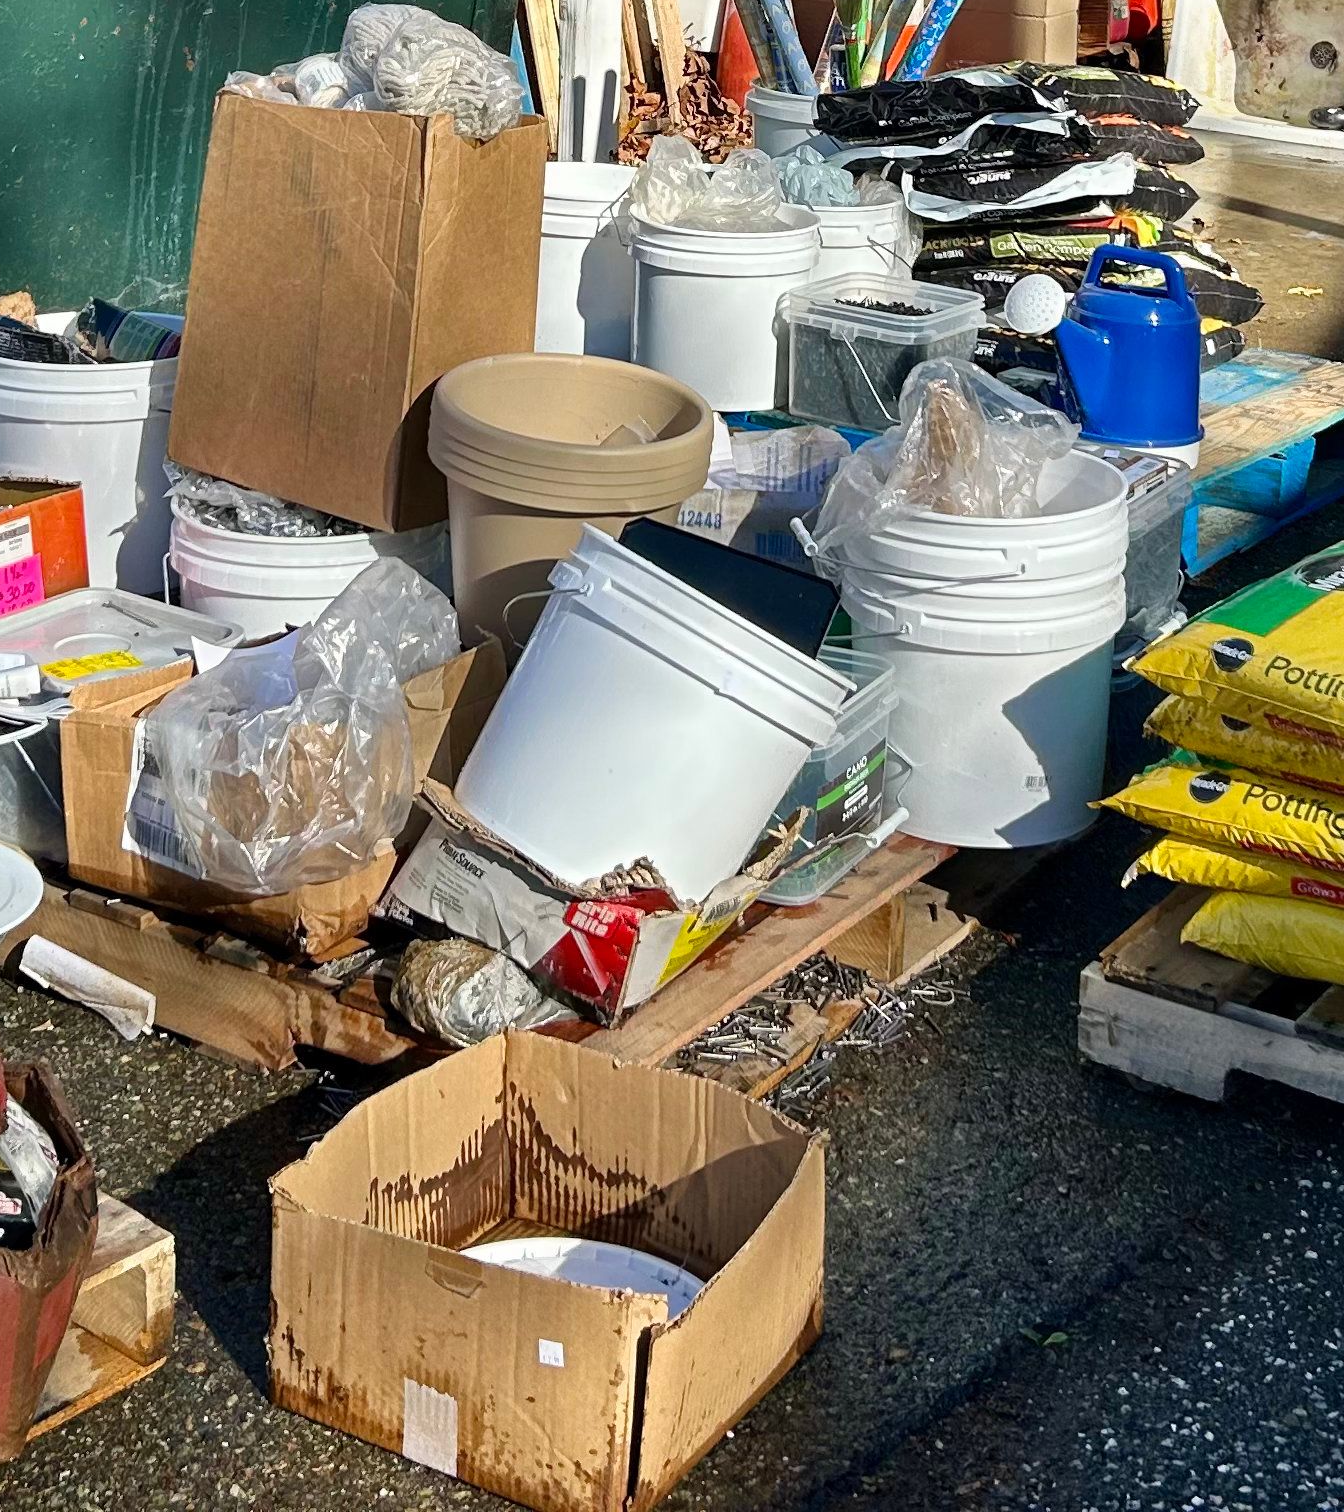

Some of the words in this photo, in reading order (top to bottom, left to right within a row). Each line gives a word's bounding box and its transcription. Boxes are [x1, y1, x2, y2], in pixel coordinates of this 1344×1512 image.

[680, 510, 722, 529] 12448
[846, 755, 868, 780] CAMO
[1297, 881, 1337, 899] Grows
[577, 901, 616, 923] Grip
[571, 914, 609, 937] Rite
